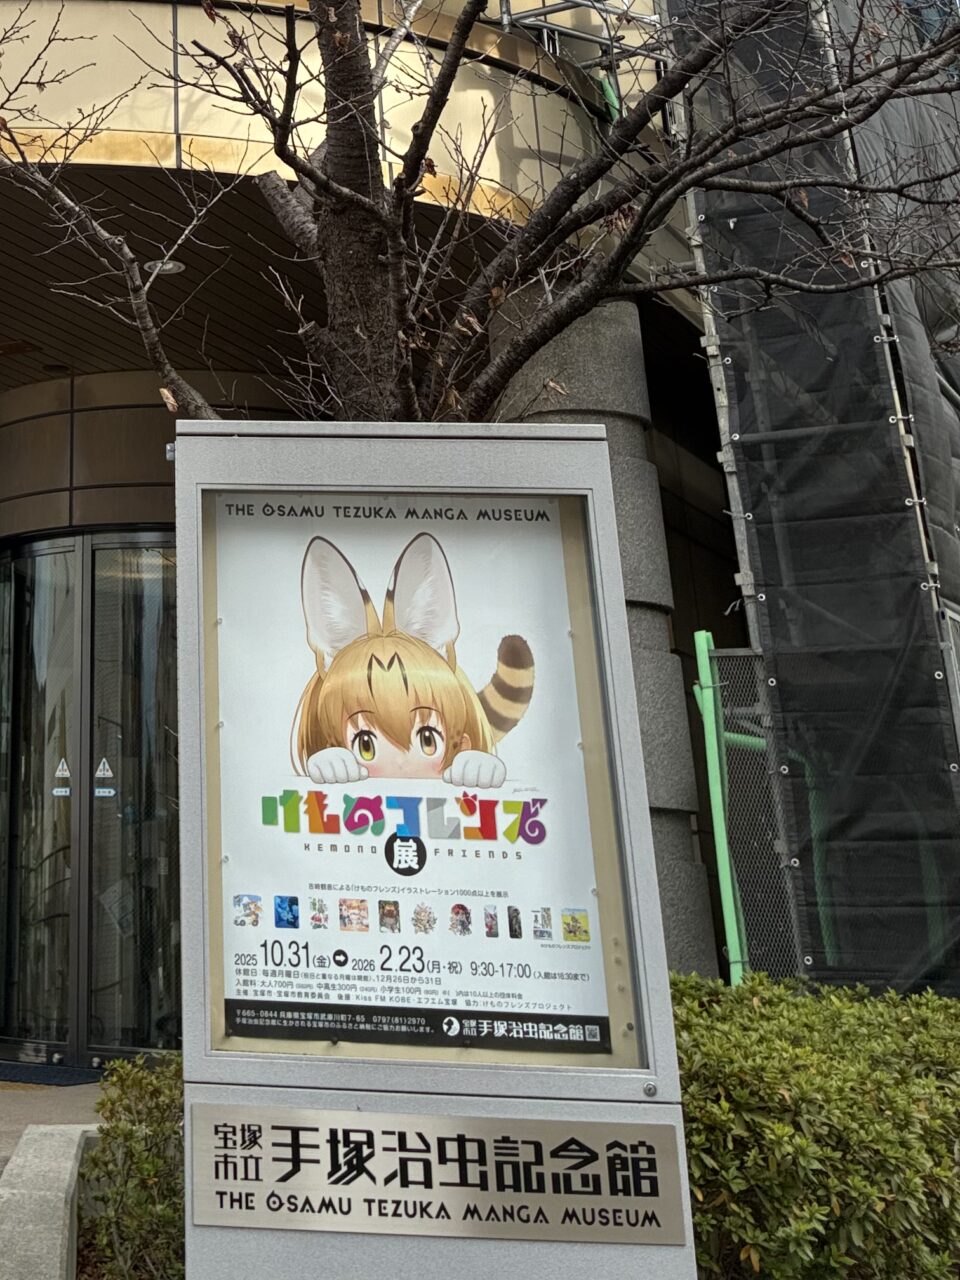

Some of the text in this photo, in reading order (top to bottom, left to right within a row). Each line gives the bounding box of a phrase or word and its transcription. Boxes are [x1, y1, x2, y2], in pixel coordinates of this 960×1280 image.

[225, 502, 551, 522] THE OSAMU TEZUKA MANGA MUSEUM
[261, 790, 549, 845] けものフレンズ
[304, 842, 522, 860] KEMONO FRIENDS
[391, 838, 421, 871] 展
[234, 953, 258, 967] 2025
[351, 959, 376, 972] 2026
[470, 961, 532, 980] 9:30-17:00
[213, 1122, 263, 1151] 宝塚
[214, 1152, 263, 1183] 市立
[270, 1123, 660, 1198] 手塚治虫記念館
[215, 1190, 662, 1229] THE OSAMU TEZUKA MANGA MUSEUM
